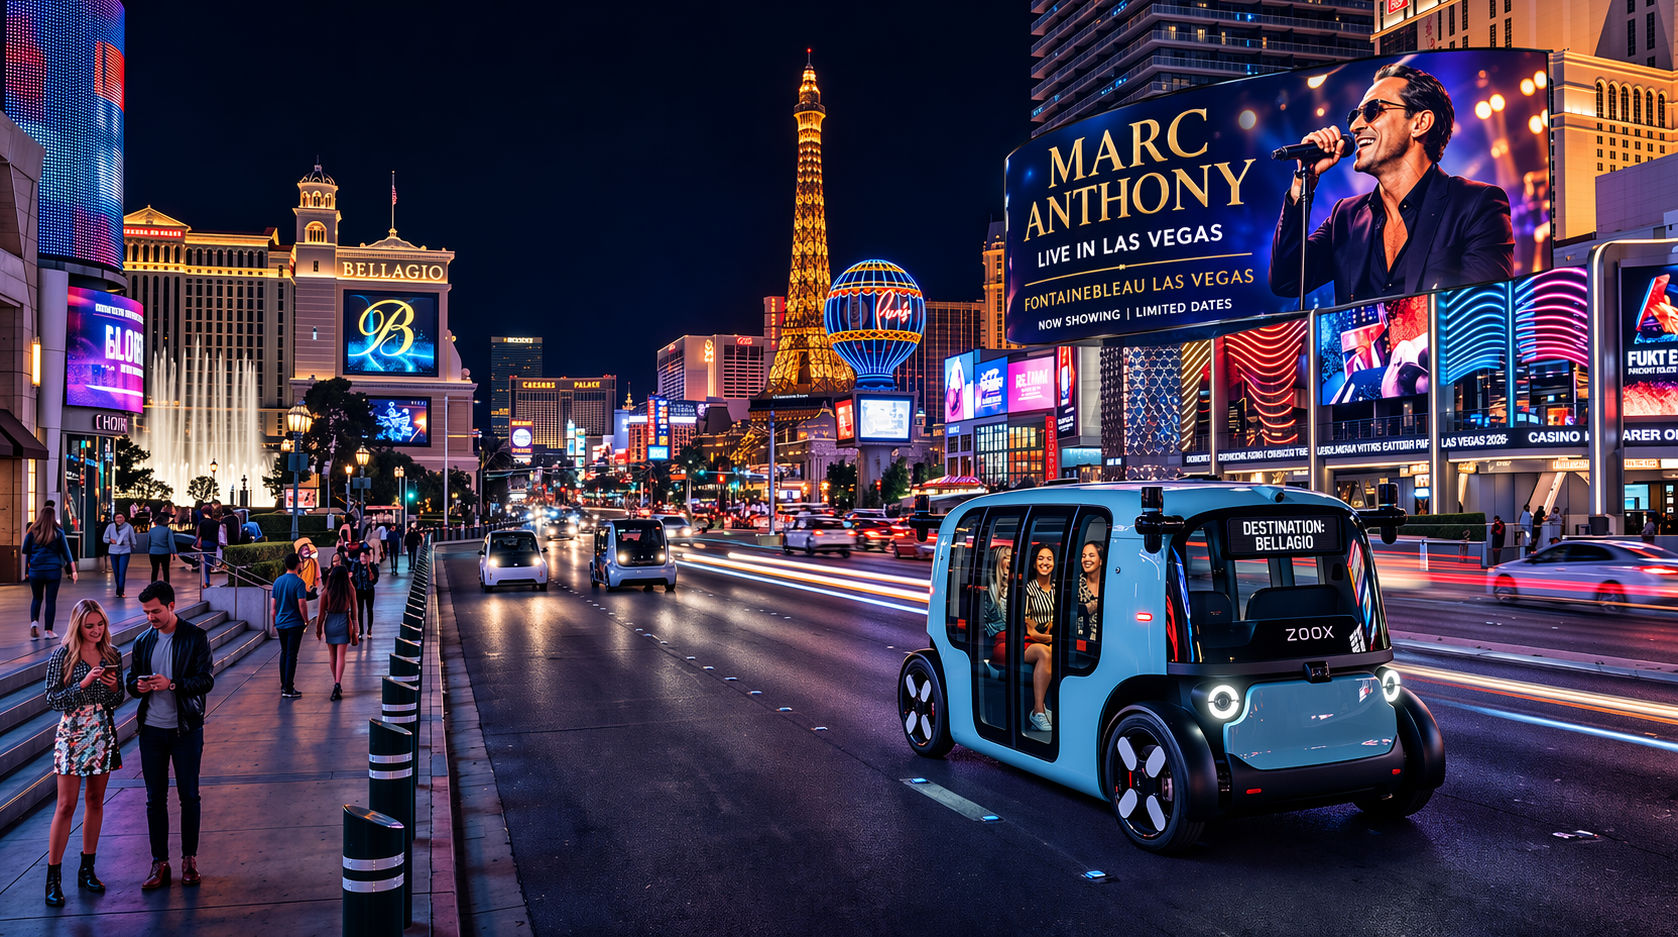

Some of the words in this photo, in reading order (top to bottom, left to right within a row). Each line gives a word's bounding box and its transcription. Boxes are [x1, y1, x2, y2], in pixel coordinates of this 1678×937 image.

[1048, 107, 1208, 189] MARC
[1023, 158, 1257, 243] ANTHONY
[1038, 245, 1070, 268] LIVE
[1077, 239, 1095, 259] IN
[1103, 232, 1140, 255] LAS
[1148, 223, 1223, 248] VEGAS
[342, 261, 444, 281] BELLAGIO
[1024, 278, 1146, 312] FONTAINEBLEAU
[1153, 274, 1184, 291] LAS
[1191, 268, 1254, 287] VEGAS
[1038, 317, 1063, 331] NOW
[1065, 309, 1121, 327] SHOWING
[1136, 302, 1187, 318] LIMITED
[1191, 298, 1233, 313] DATES
[353, 299, 415, 357] B
[1441, 437, 1457, 448] LAS
[1457, 435, 1486, 447] VEGAS
[1528, 430, 1581, 443] CASINO
[1242, 519, 1326, 537] DESTINATION:
[1255, 535, 1314, 551] BELLAGIO
[1285, 625, 1335, 642] ZOOX
